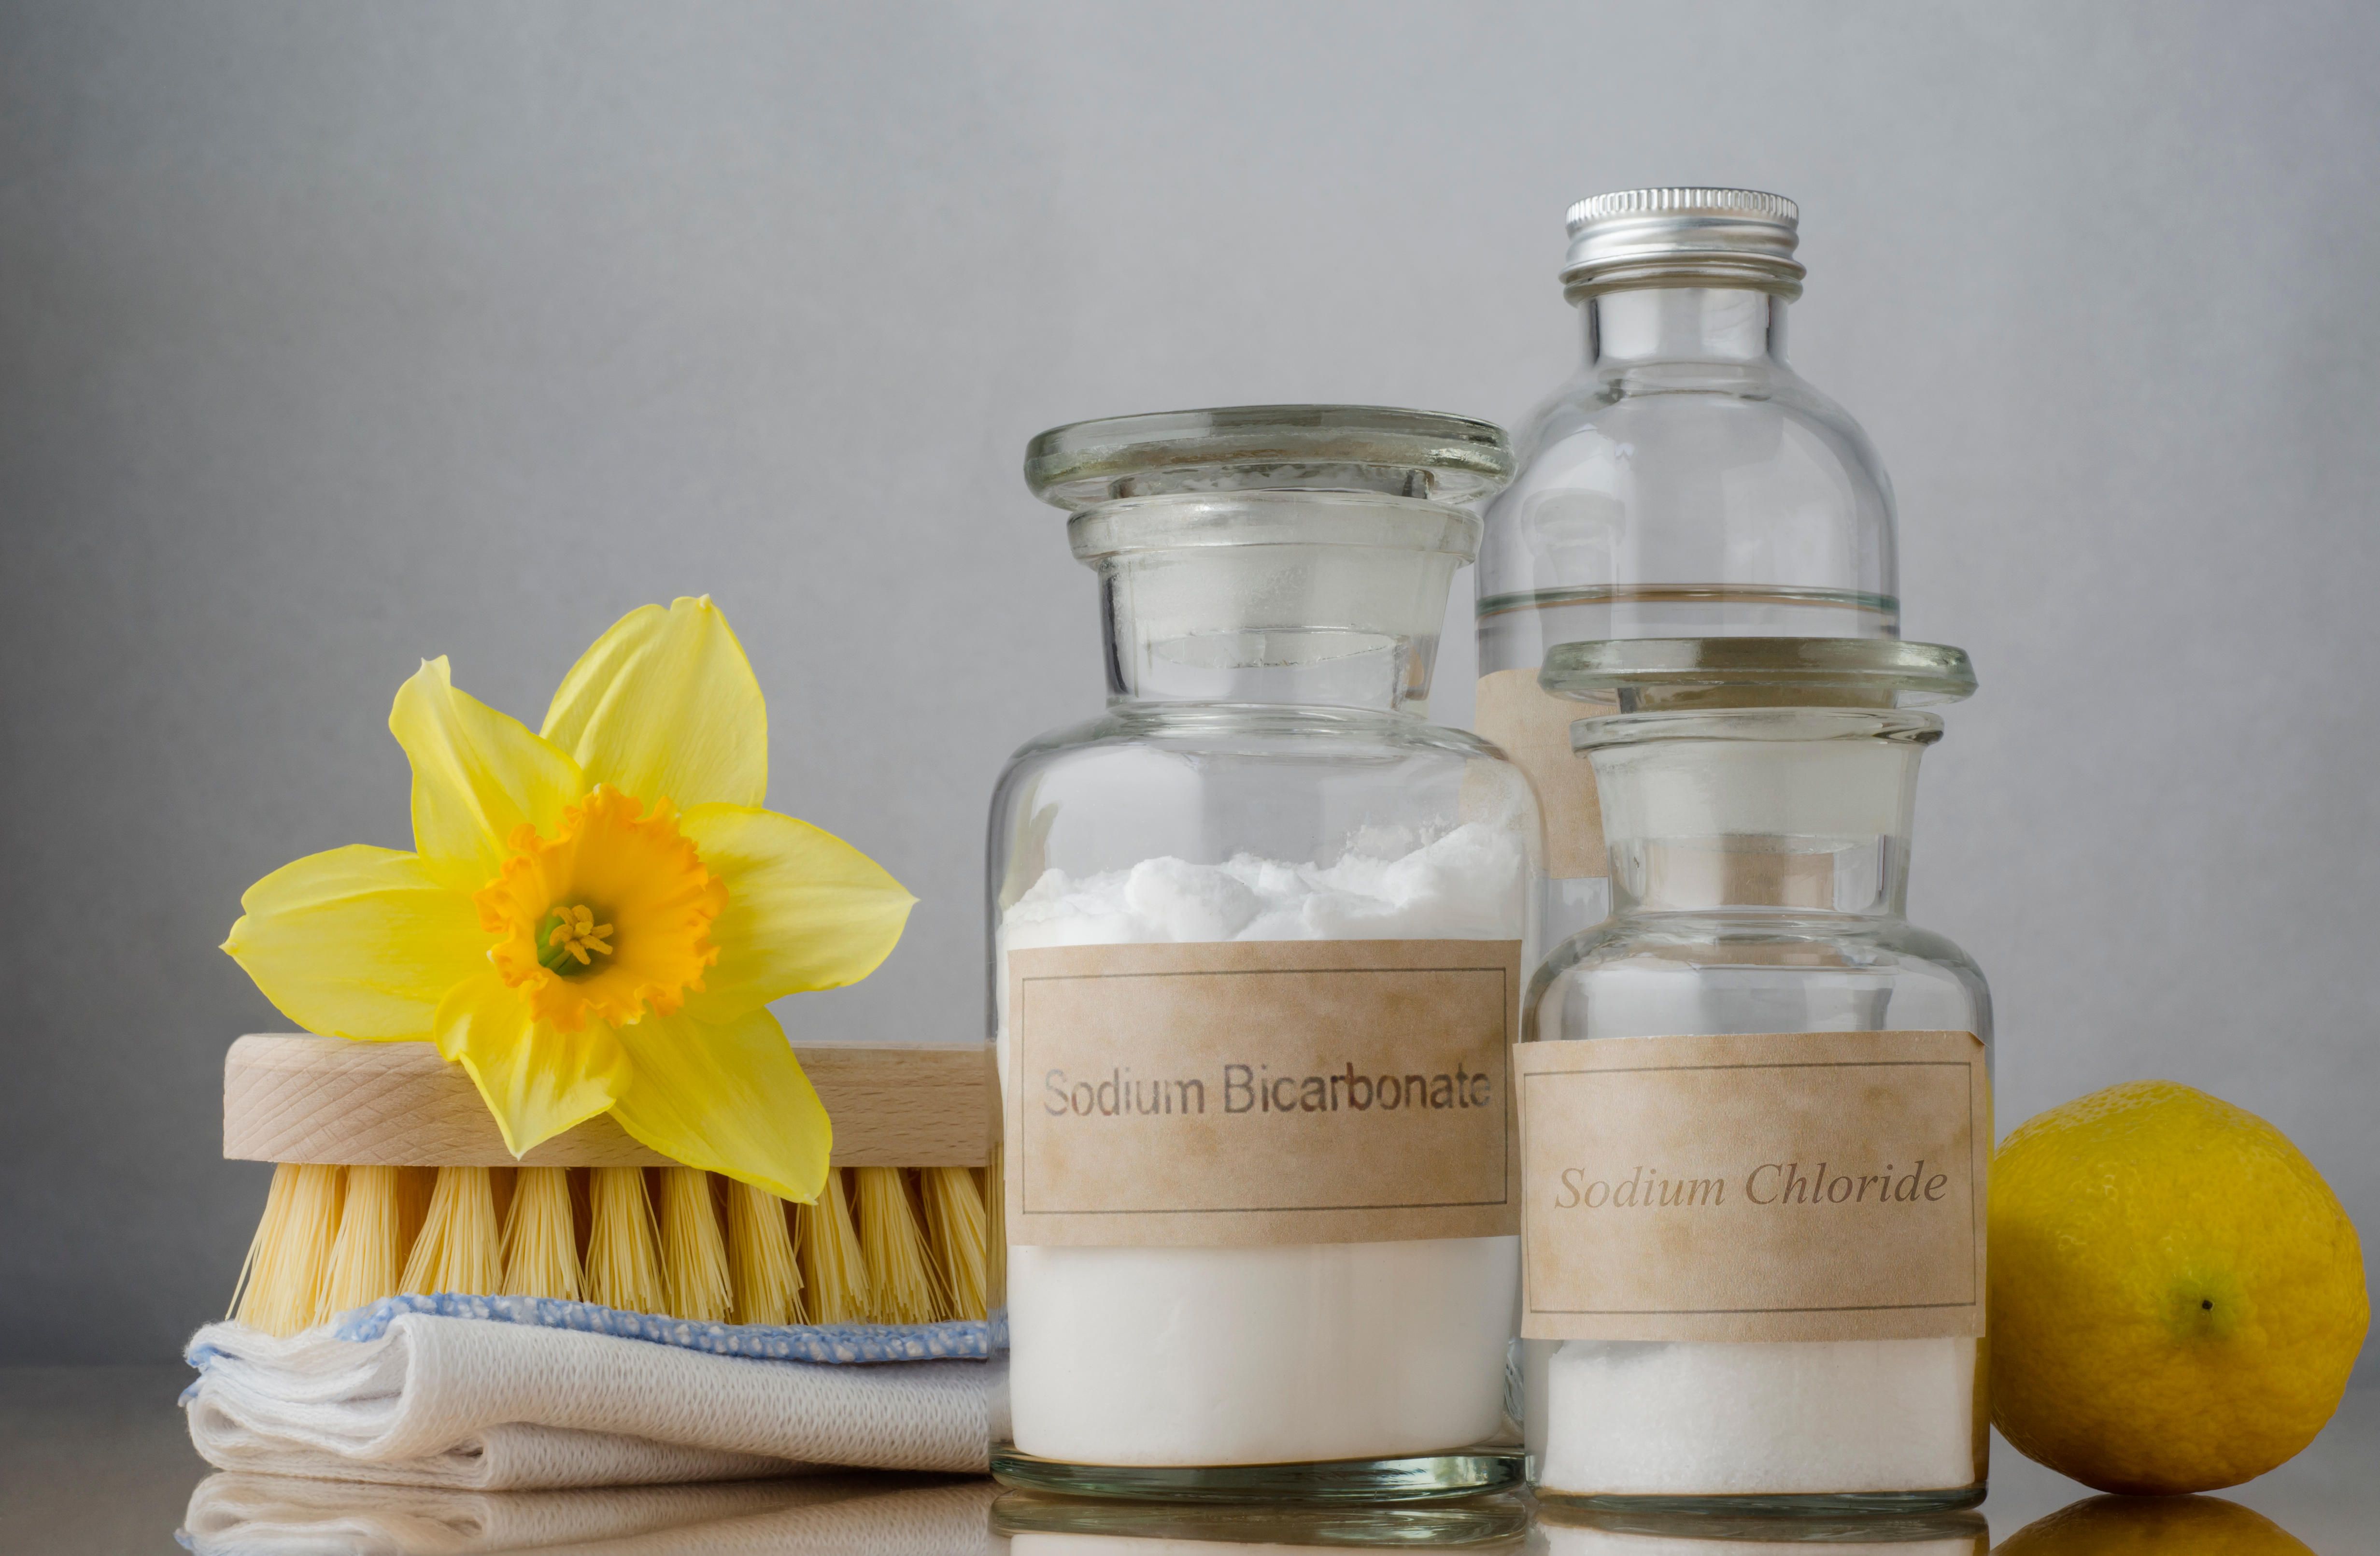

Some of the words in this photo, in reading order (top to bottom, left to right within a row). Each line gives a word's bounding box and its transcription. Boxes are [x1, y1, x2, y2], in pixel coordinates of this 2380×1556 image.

[1043, 1067, 1205, 1116] Sodium
[1223, 1062, 1491, 1113] Bicarbonate
[1555, 1166, 1724, 1209] Sodium
[1745, 1160, 1948, 1205] Chloride
